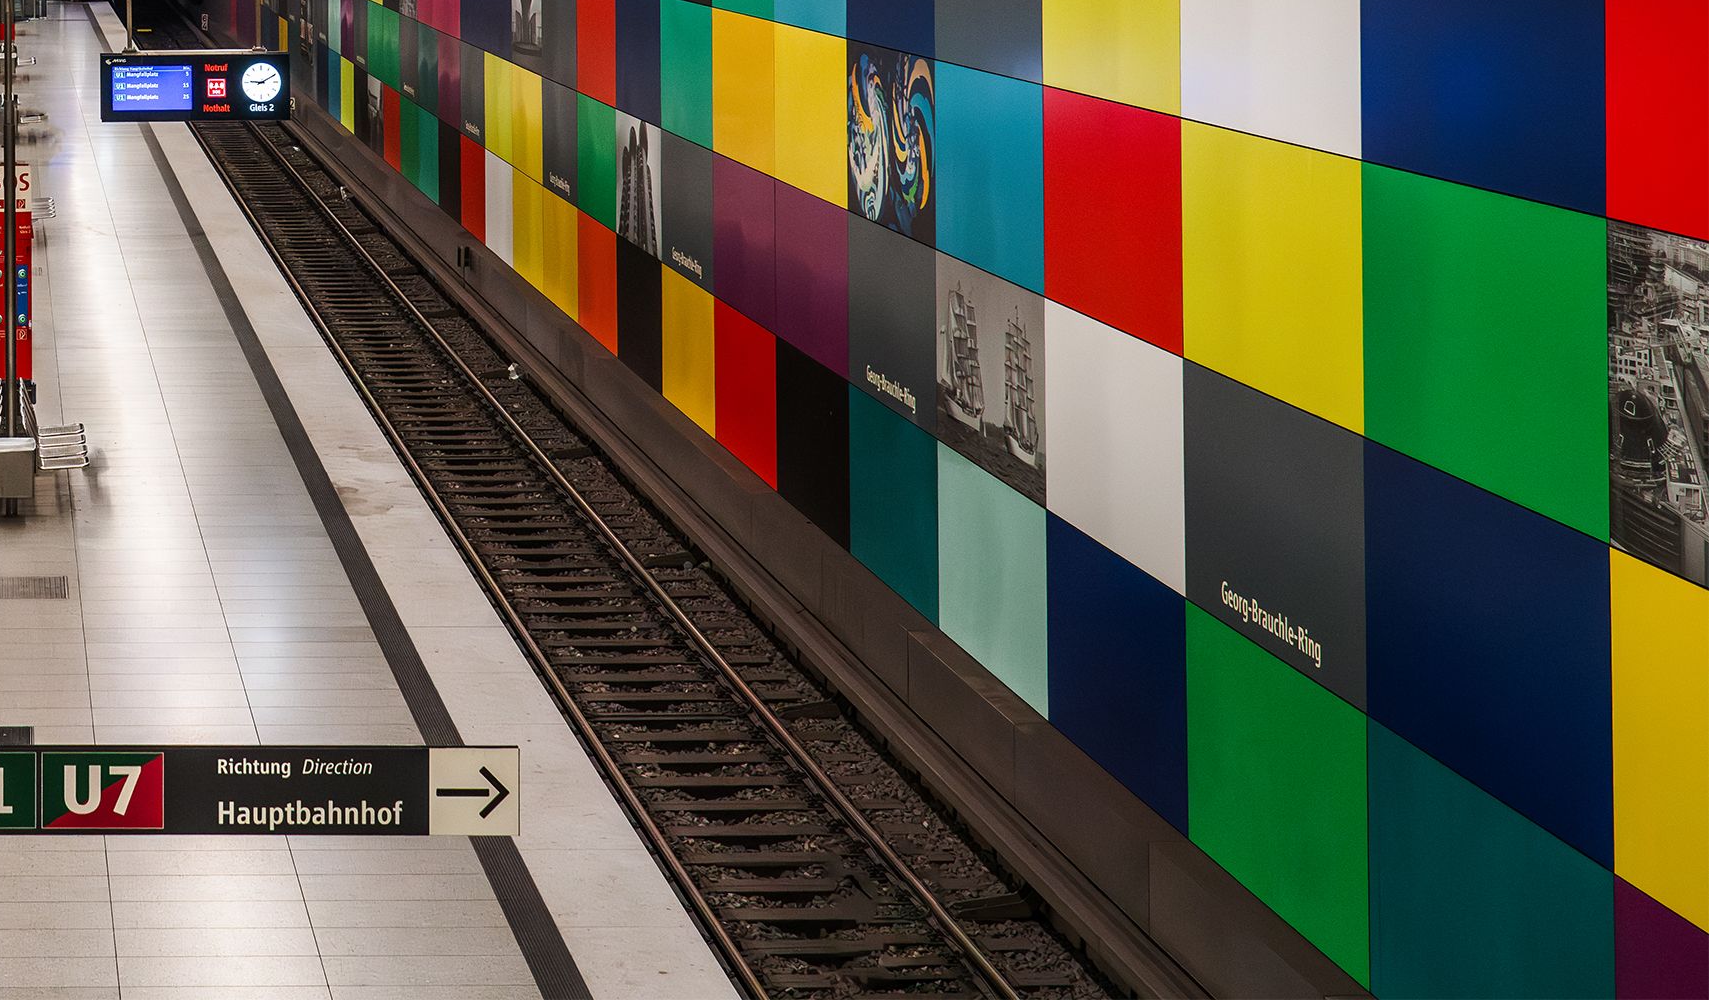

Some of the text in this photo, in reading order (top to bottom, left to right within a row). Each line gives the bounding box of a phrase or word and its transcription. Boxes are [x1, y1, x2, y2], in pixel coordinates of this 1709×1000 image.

[204, 63, 228, 72] Notruf
[203, 103, 231, 112] Nothalt
[249, 103, 275, 112] Gleis 2
[866, 364, 916, 414] Georg-Brauchle-Ring
[1221, 580, 1322, 669] Georg-Brauchle-Ring
[217, 757, 373, 779] Richtung Direction
[63, 764, 142, 816] U7
[217, 799, 404, 831] Hauptbahnhof
